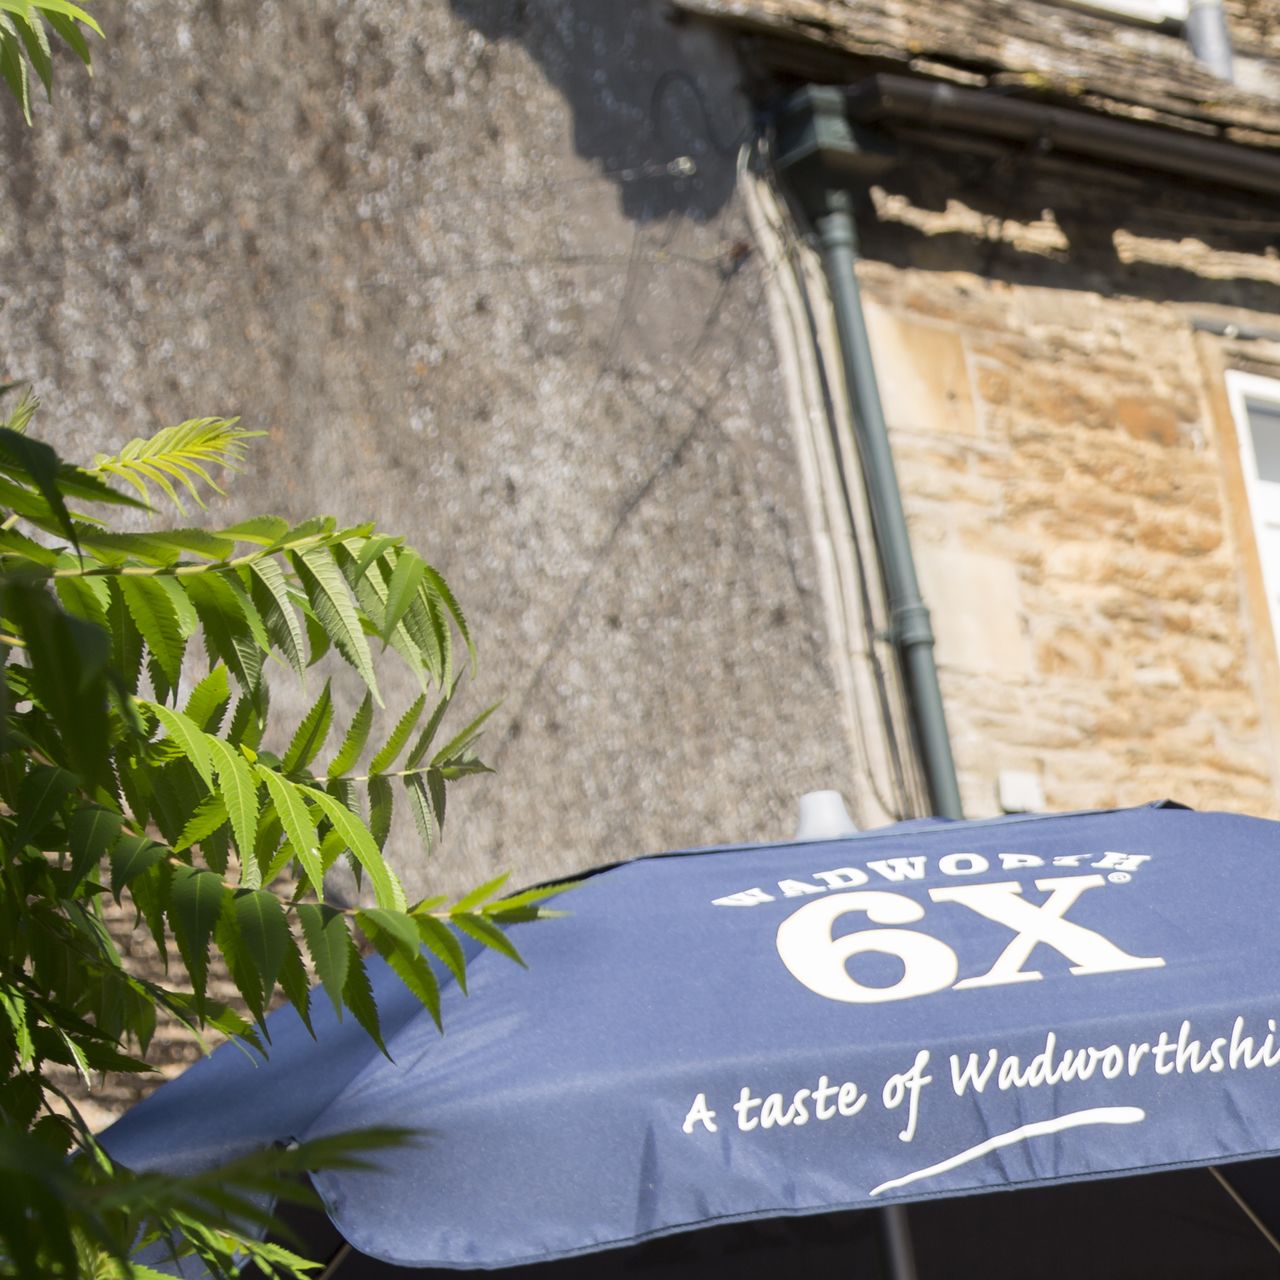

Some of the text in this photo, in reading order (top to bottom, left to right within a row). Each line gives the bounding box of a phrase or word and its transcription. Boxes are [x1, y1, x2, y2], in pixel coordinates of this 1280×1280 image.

[776, 874, 1166, 1003] 6X
[682, 1093, 717, 1134] A
[734, 1073, 868, 1132] taste
[882, 1050, 931, 1142] of
